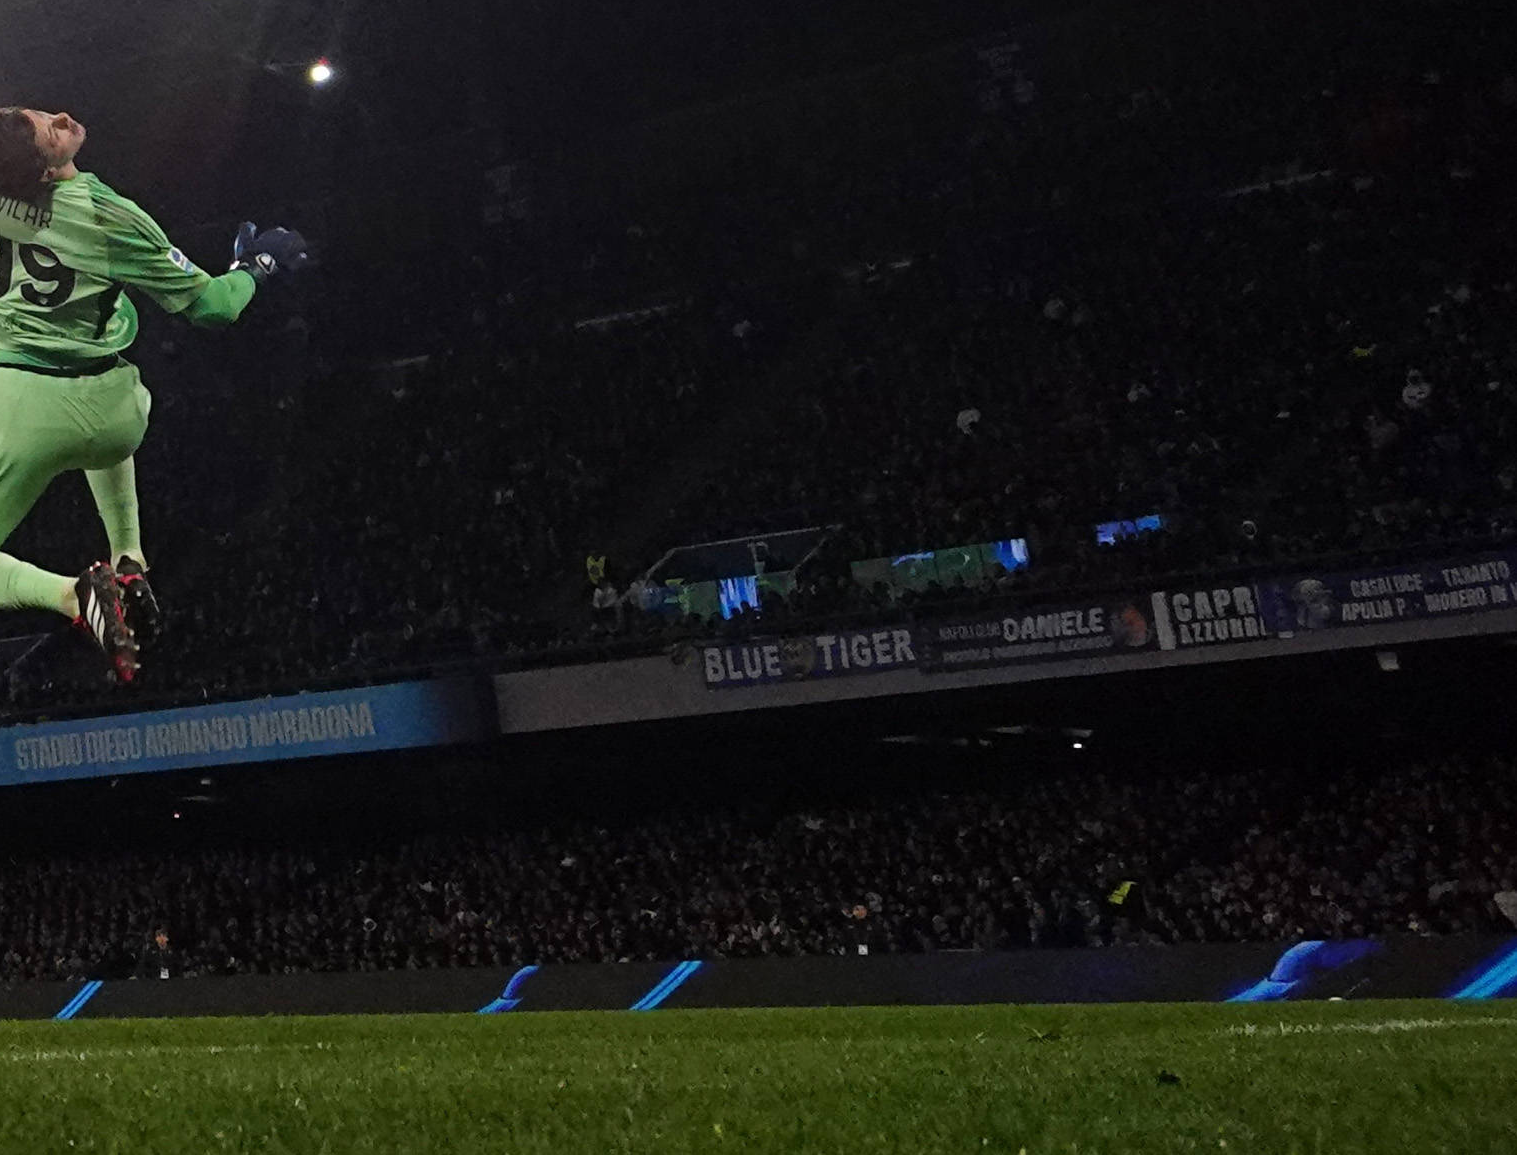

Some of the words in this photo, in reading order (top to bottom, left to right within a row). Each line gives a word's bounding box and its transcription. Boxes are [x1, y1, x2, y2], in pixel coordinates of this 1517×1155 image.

[1002, 607, 1105, 642] DANIELE
[704, 645, 783, 683] BLUE
[815, 629, 917, 671] TIGER
[16, 732, 83, 770] STADIO
[84, 727, 142, 764] DIEGO
[145, 715, 248, 758] ARMANDO
[249, 701, 376, 748] MARADONA
